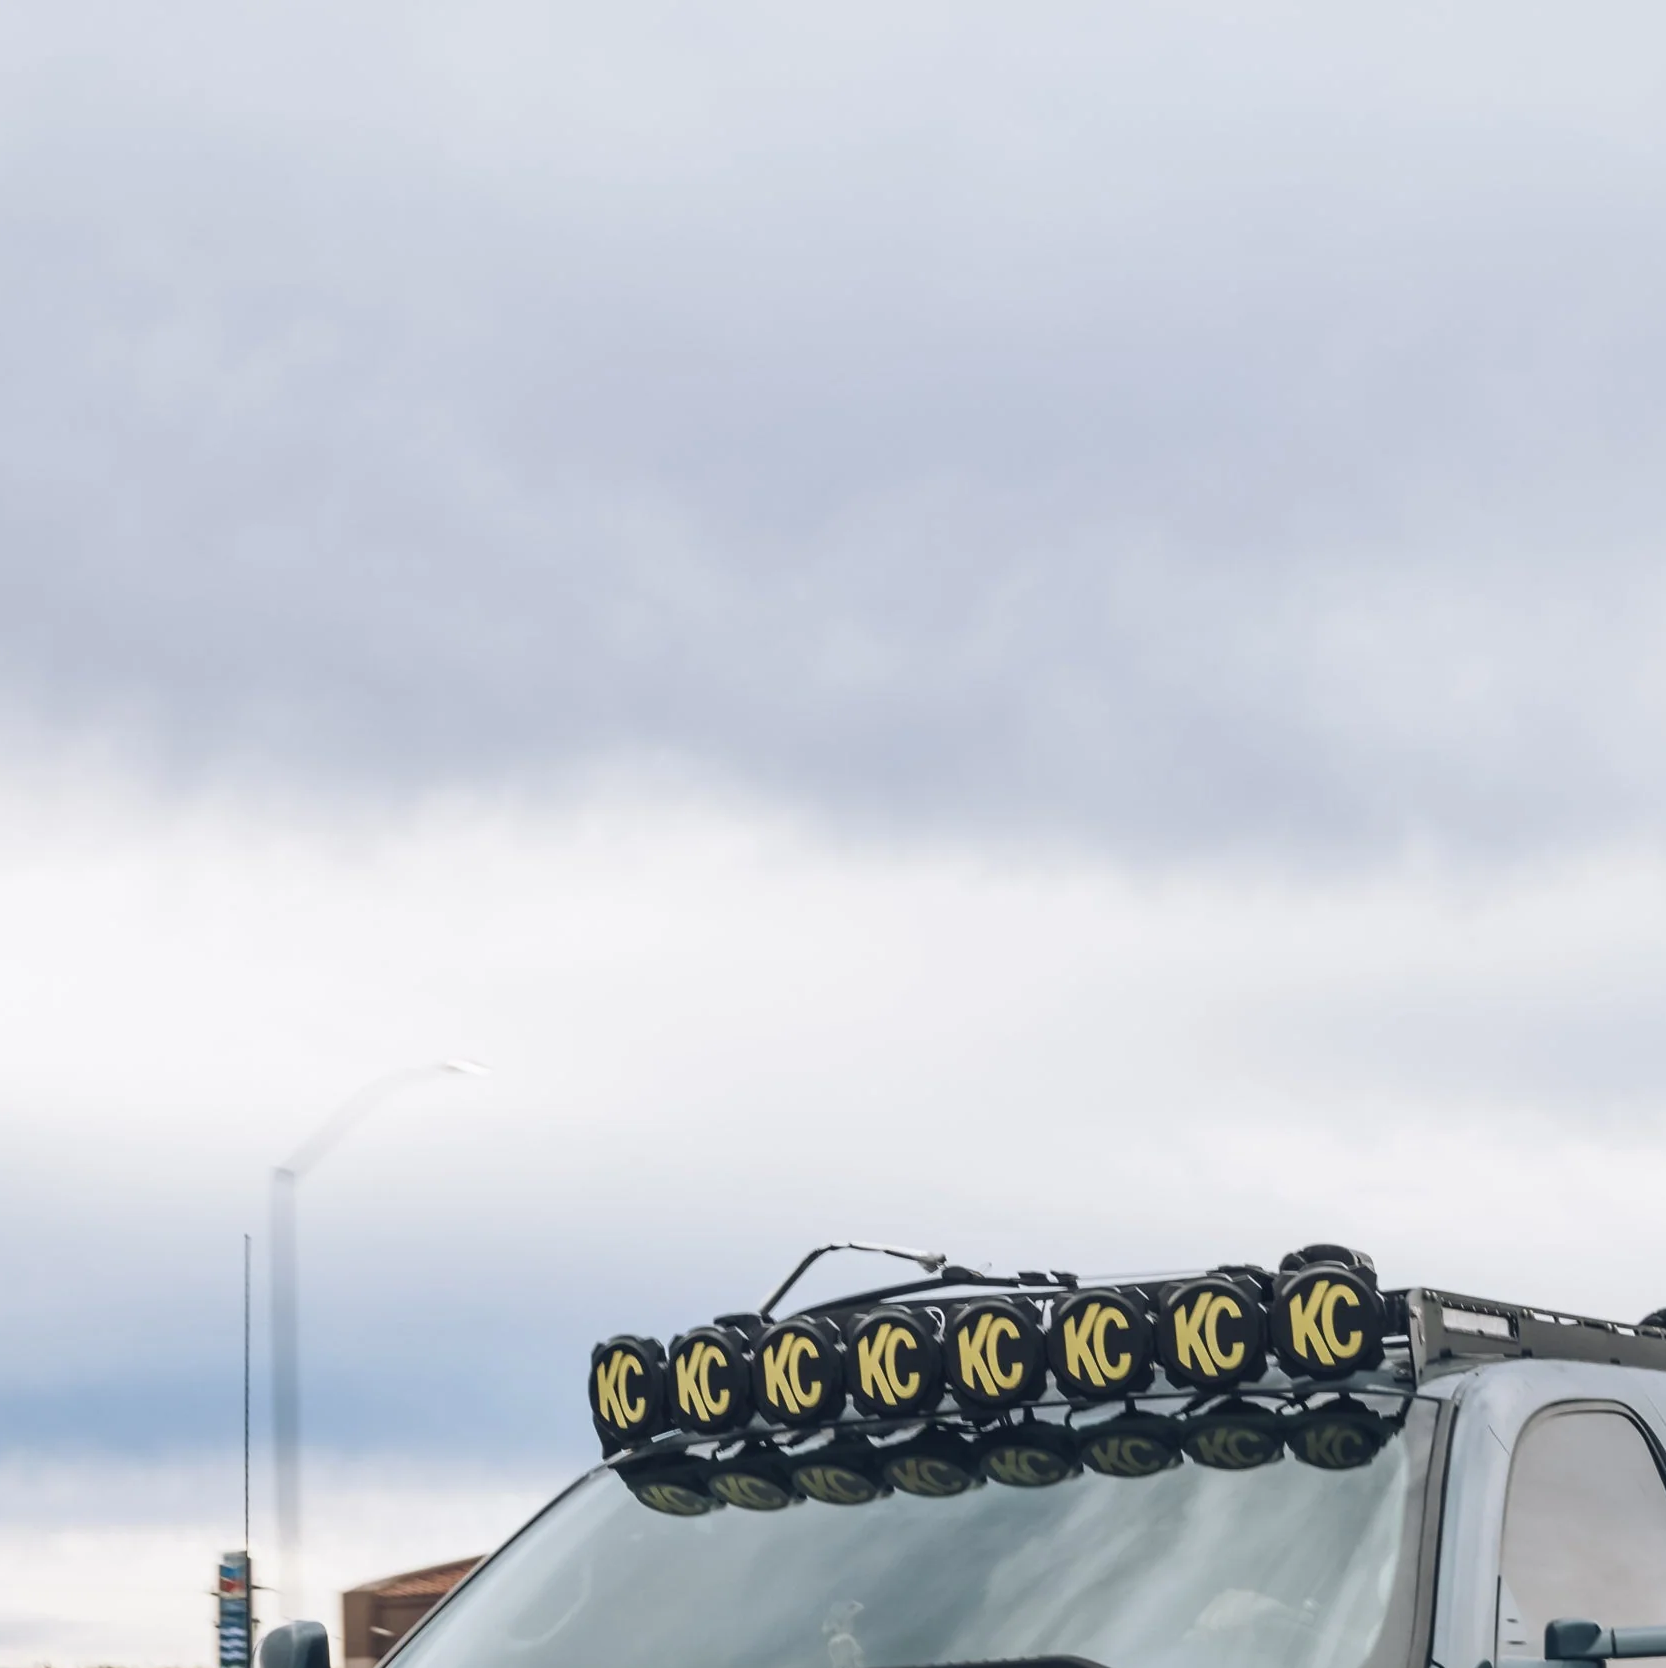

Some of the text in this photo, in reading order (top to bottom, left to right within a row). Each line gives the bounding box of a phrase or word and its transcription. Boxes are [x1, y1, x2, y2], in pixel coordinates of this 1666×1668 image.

[957, 1313, 1024, 1396] KC
[1063, 1304, 1132, 1387] KC
[1174, 1292, 1245, 1377] KC
[1290, 1280, 1363, 1365] KC
[596, 1351, 646, 1429] KC
[676, 1342, 730, 1421] KC
[764, 1332, 822, 1414] KC
[858, 1323, 920, 1406] KC
